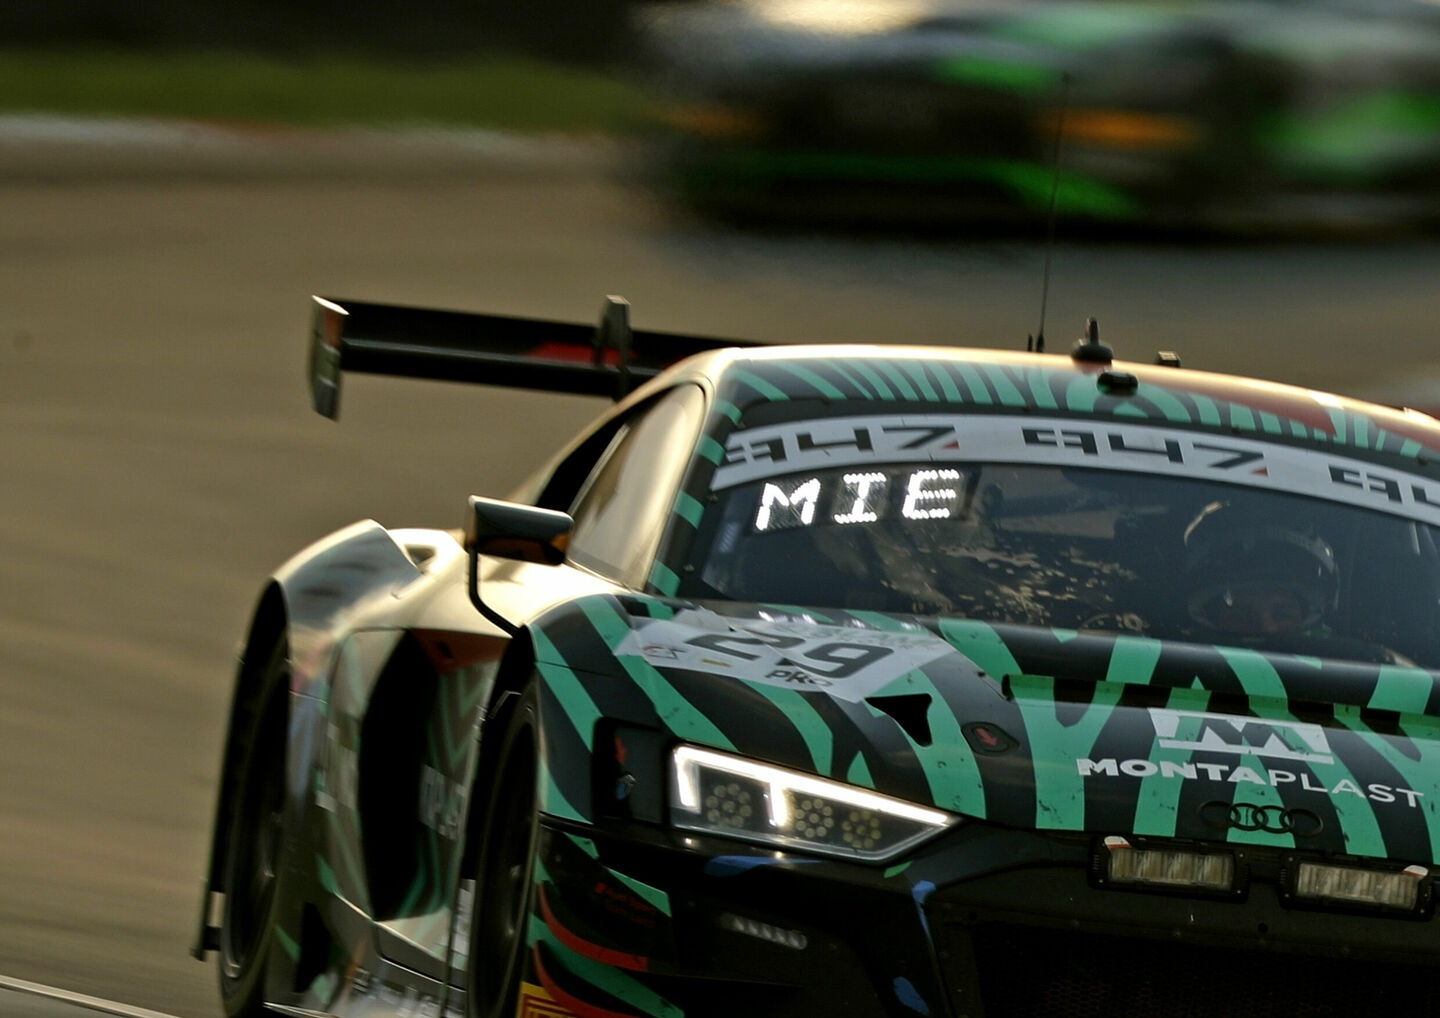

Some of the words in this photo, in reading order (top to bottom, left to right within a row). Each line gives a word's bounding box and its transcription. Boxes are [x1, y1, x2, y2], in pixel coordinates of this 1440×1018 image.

[754, 468, 961, 532] MIE
[685, 634, 895, 678] 29
[1076, 757, 1424, 808] MONTAPLAST
